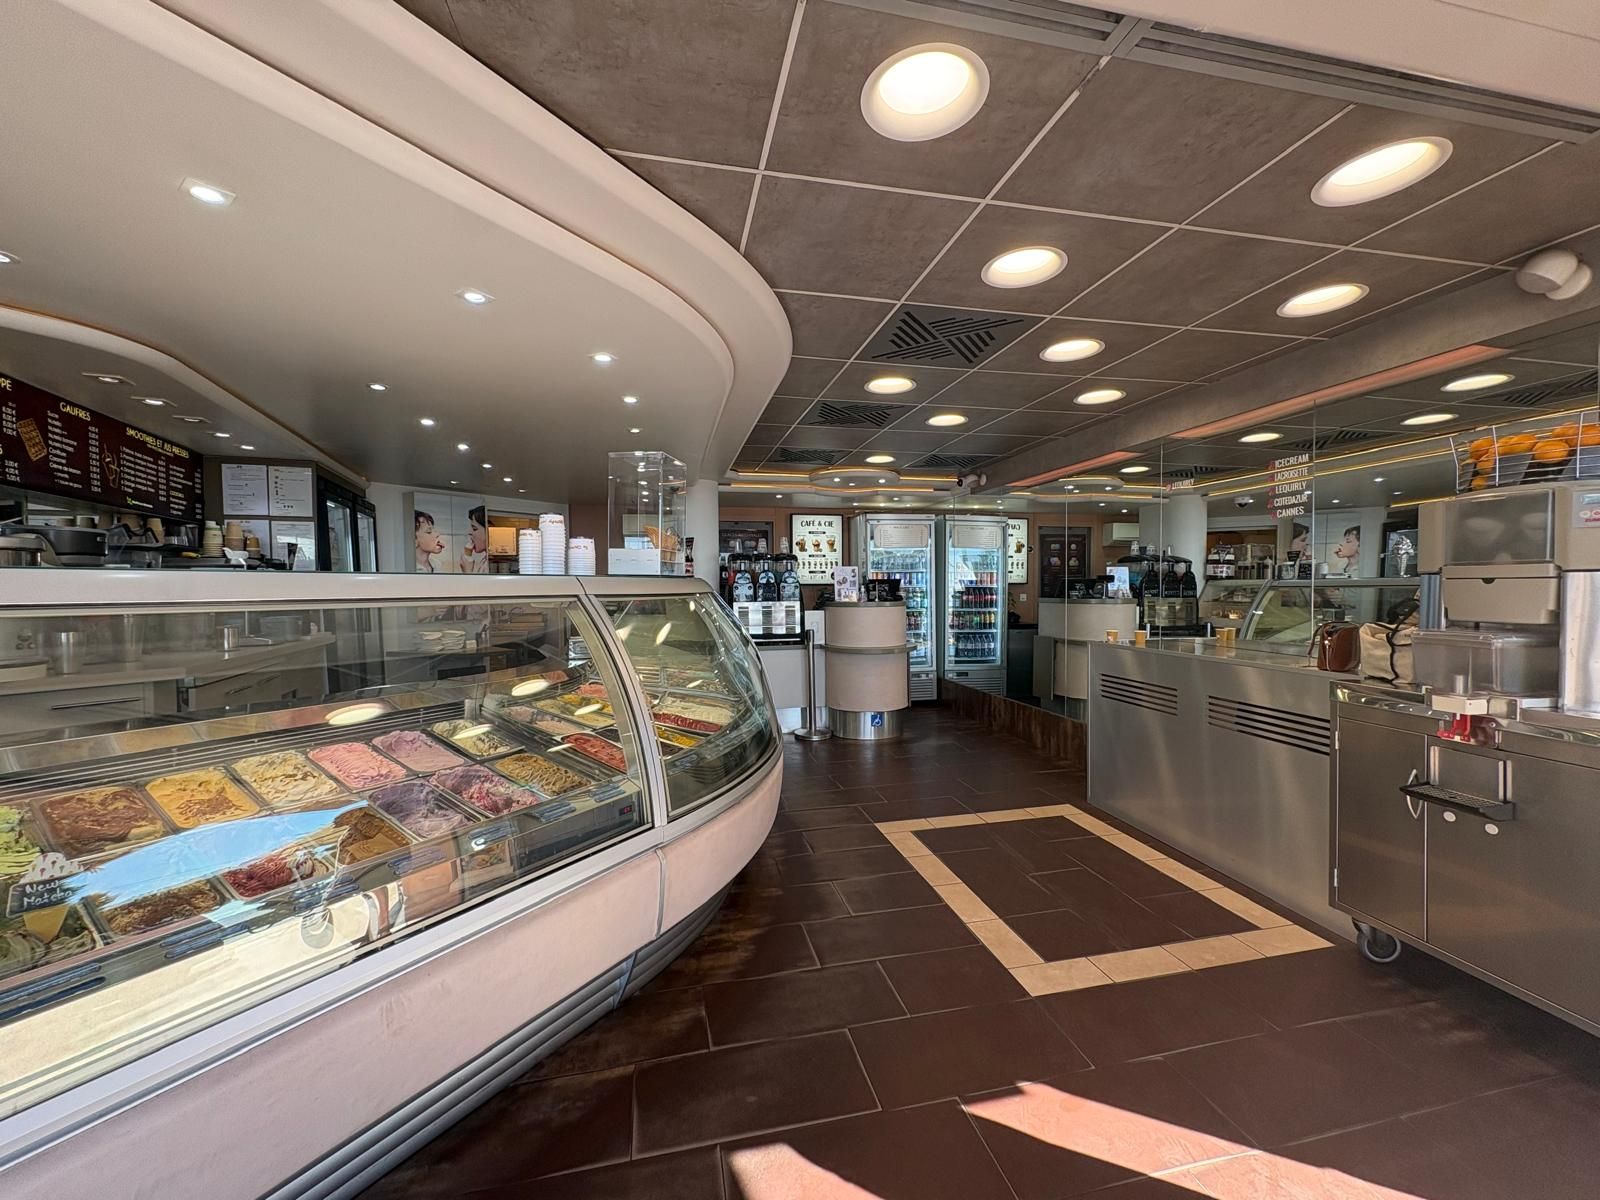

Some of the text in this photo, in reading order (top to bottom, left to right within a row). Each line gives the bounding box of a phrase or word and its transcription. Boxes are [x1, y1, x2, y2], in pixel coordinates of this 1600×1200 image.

[60, 402, 91, 421] GAUFRES
[1276, 506, 1305, 518] CANNES
[25, 880, 61, 894] New
[23, 888, 74, 909] Matcha
